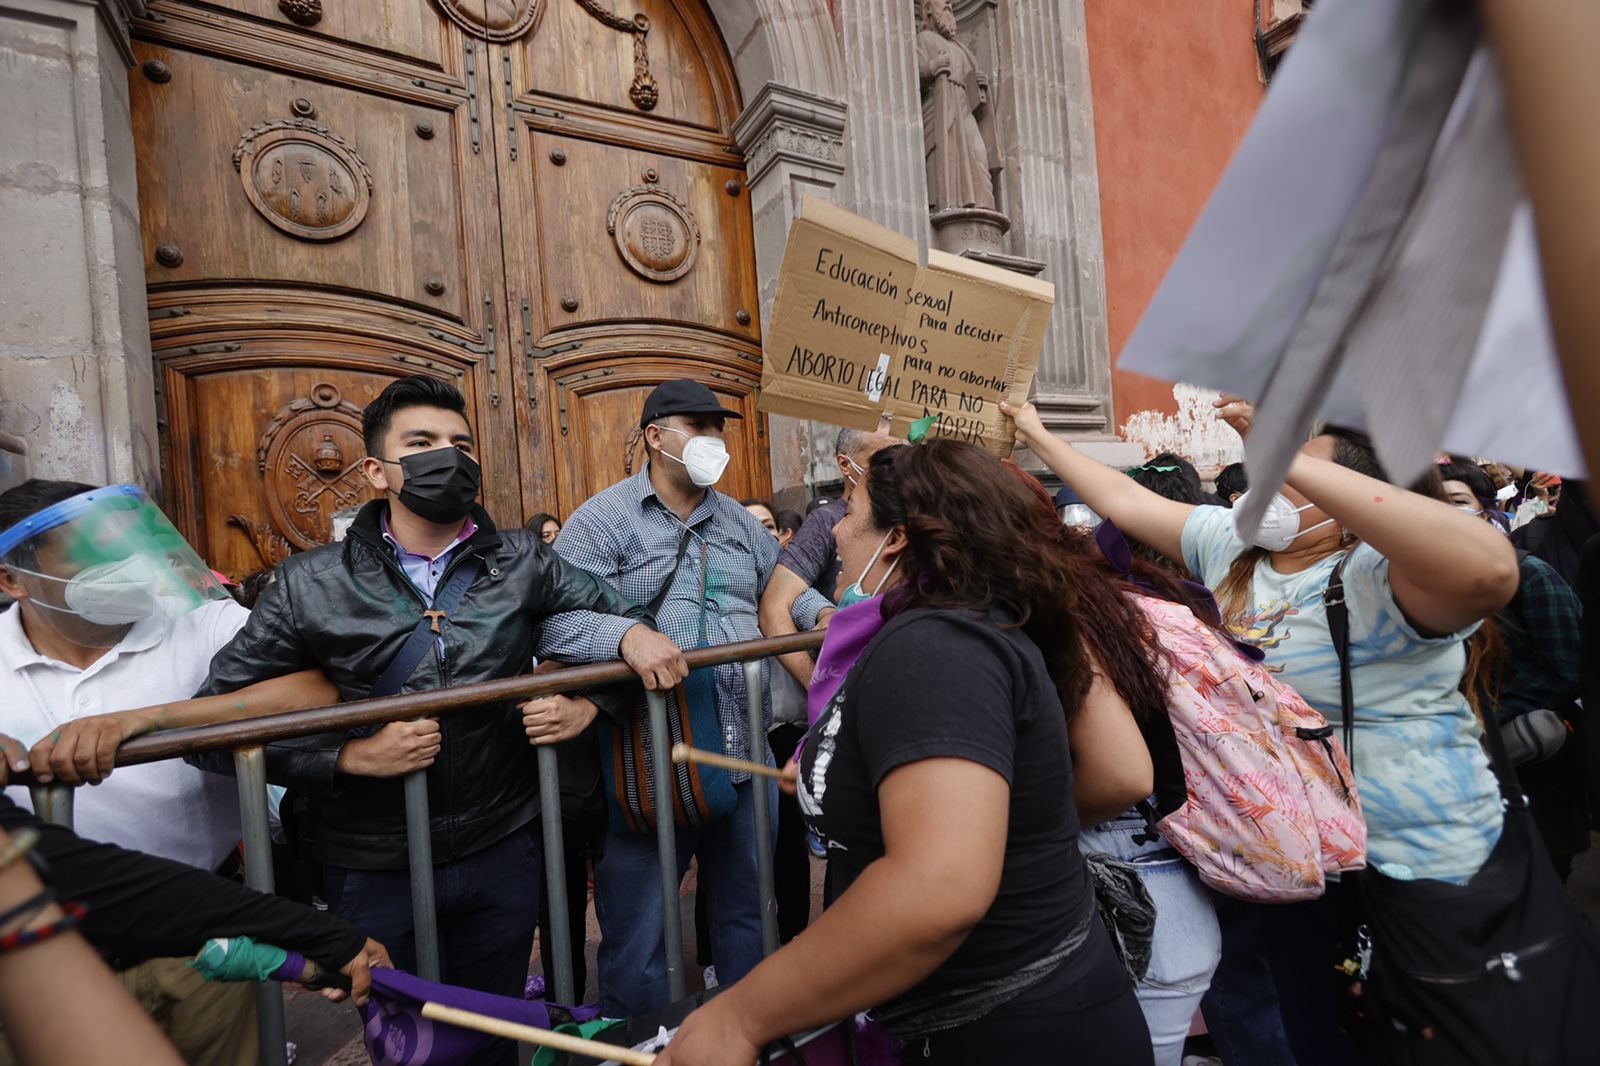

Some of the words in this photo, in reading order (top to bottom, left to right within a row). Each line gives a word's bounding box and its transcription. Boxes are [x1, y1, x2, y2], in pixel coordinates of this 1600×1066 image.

[815, 247, 898, 300] Educación
[904, 287, 953, 317] sexual
[812, 298, 928, 354] Anticonceptivos
[954, 319, 1004, 343] decidir
[785, 345, 855, 385] ABORTO
[857, 364, 901, 400] LEGAL
[911, 379, 948, 409] PARA
[958, 391, 984, 414] NO
[938, 365, 956, 378] no
[959, 370, 1009, 393] abortar
[439, 577, 466, 611] POLO
